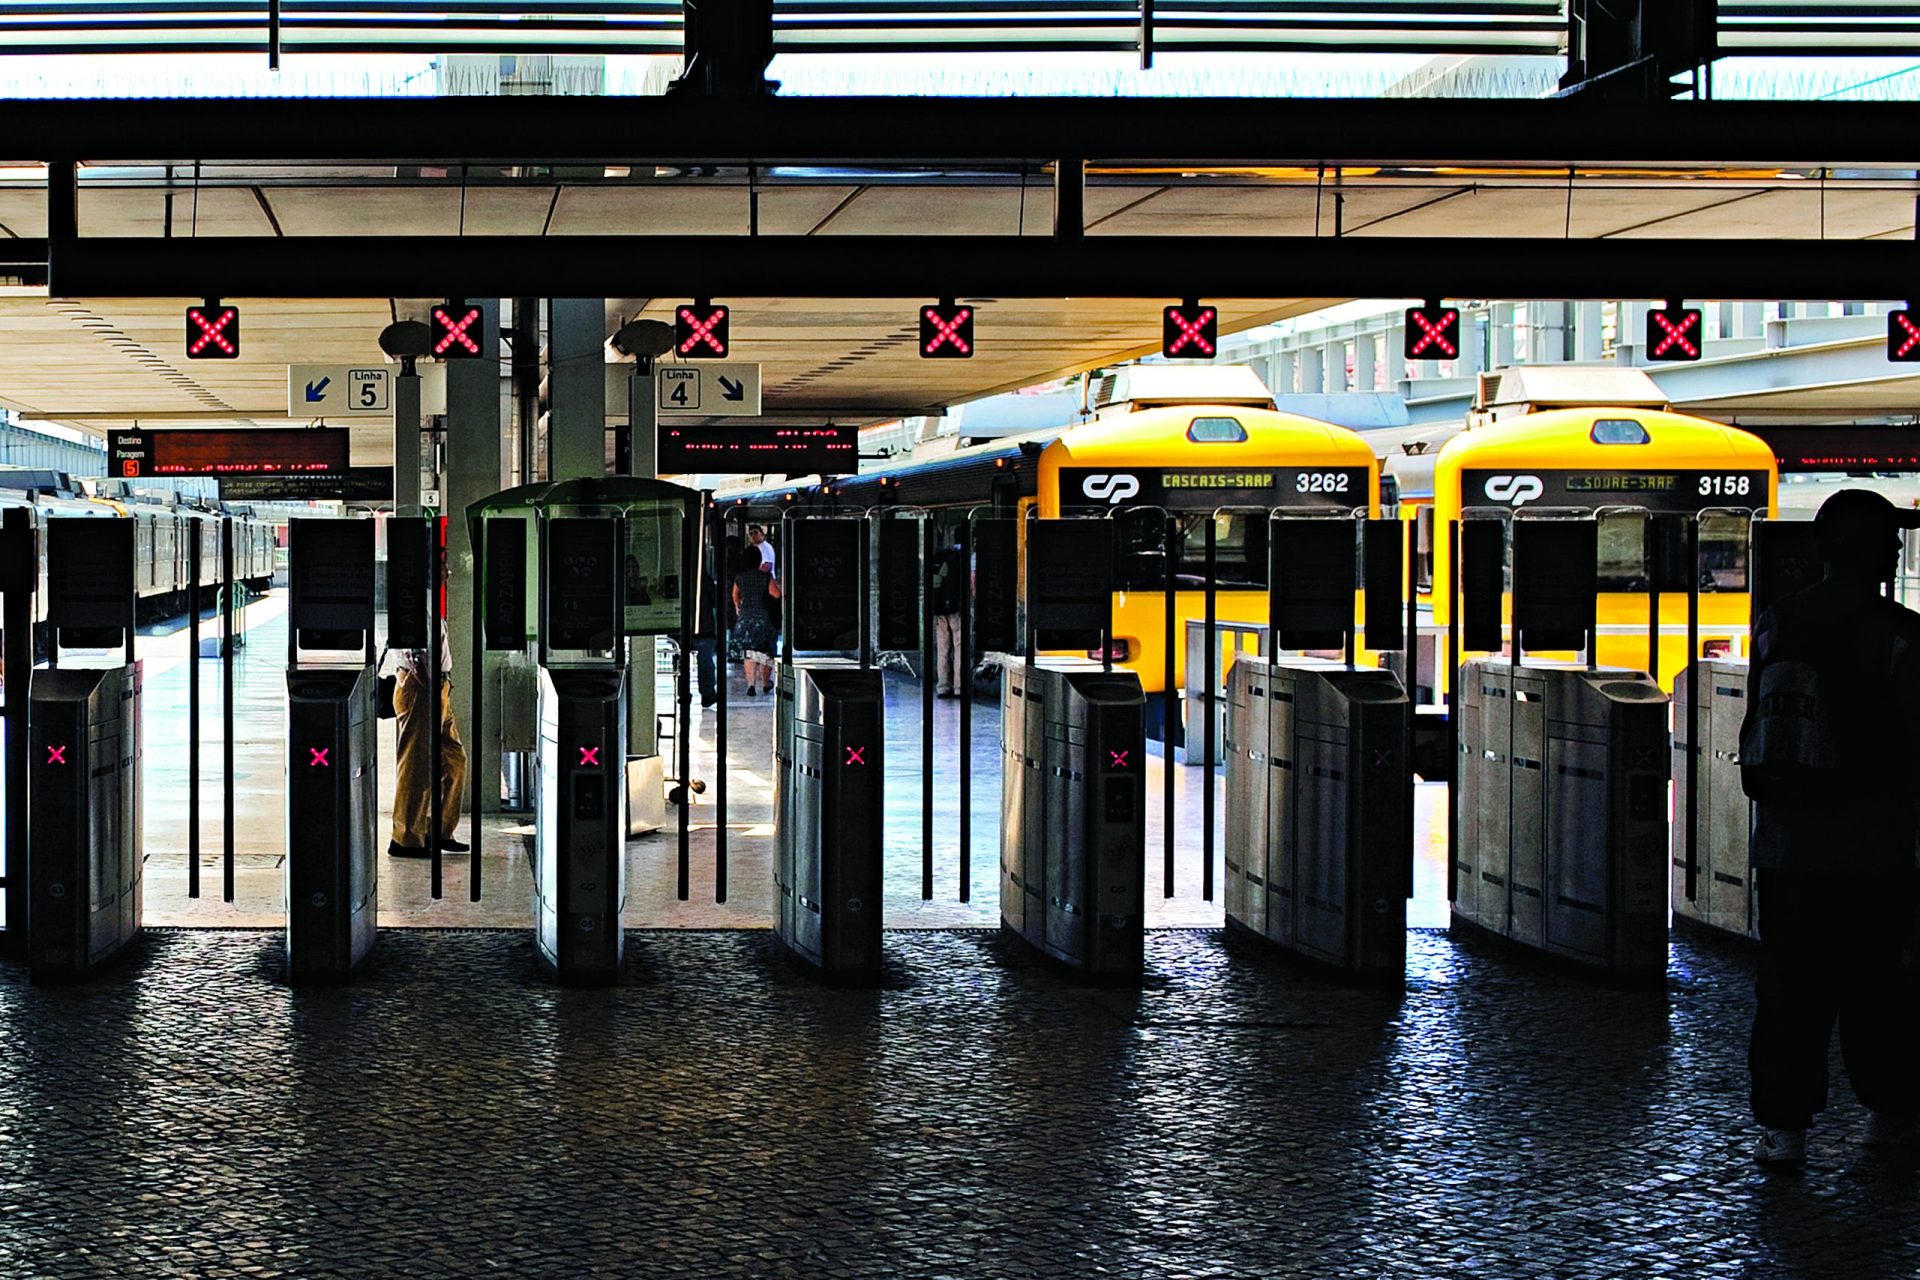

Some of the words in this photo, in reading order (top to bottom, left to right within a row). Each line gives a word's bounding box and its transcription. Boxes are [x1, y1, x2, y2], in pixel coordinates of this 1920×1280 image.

[354, 371, 382, 380] Linha
[666, 371, 694, 380] Linha
[360, 383, 377, 407] 5
[671, 382, 688, 406] 4
[117, 435, 142, 445] Destino
[116, 449, 145, 460] Paragem
[126, 461, 136, 475] 5
[1295, 472, 1349, 493] 3262
[1698, 475, 1750, 496] 3158
